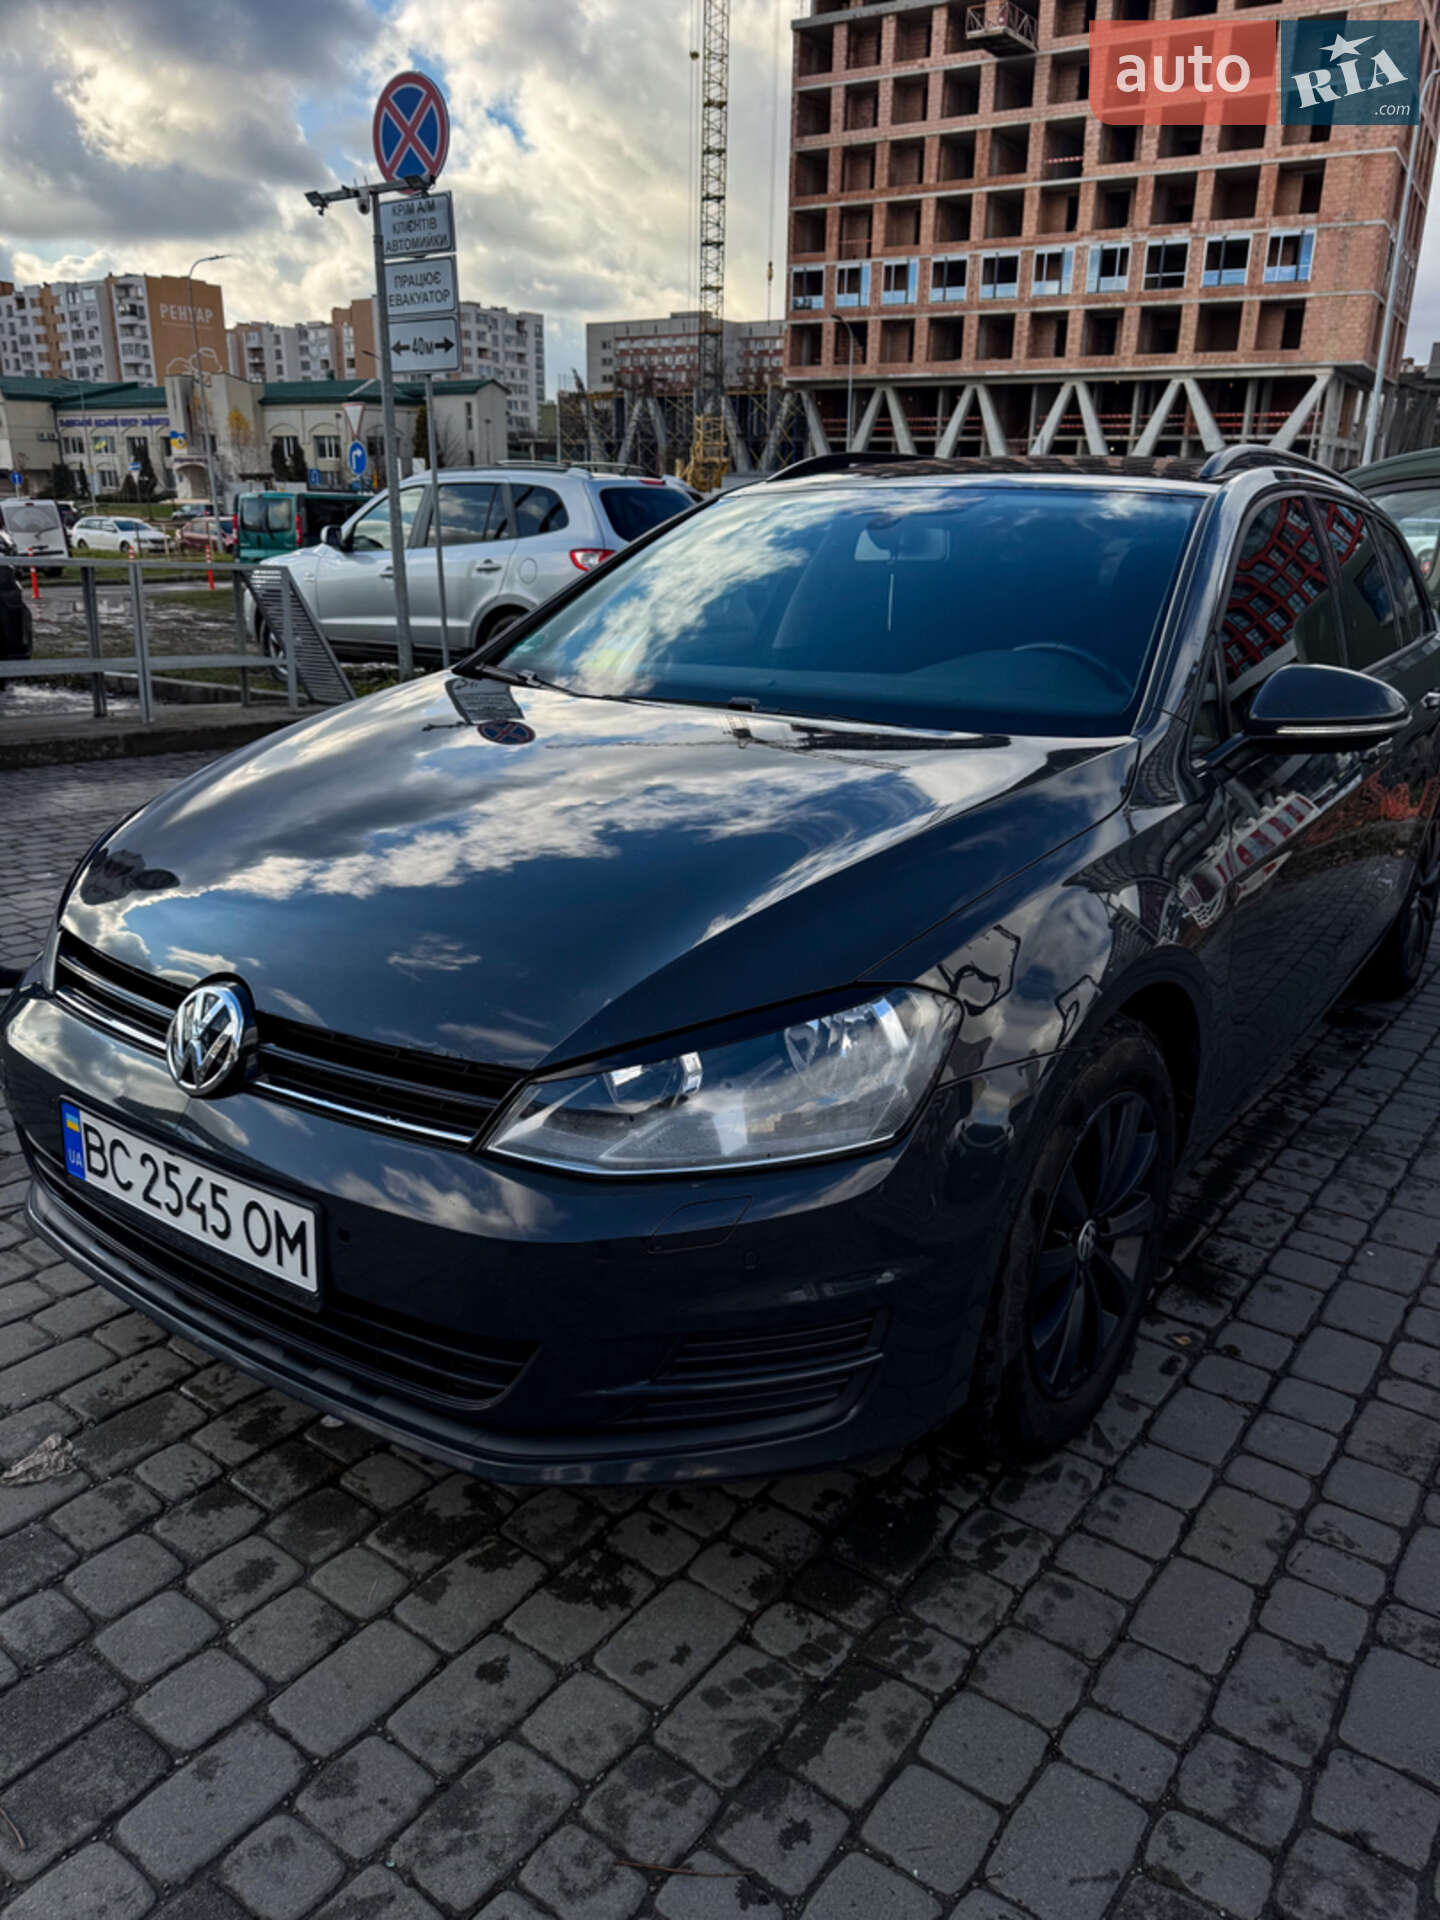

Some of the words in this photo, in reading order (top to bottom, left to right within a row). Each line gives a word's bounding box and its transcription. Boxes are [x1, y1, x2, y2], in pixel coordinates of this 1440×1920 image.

[392, 217, 437, 234] КЛІЄНТІВ
[385, 234, 448, 252] АВТОМИЙКИ
[394, 271, 442, 289] ПРАЦЮЄ
[389, 290, 450, 307] ЕВАКУАТОР
[68, 1148, 83, 1168] UA
[83, 1123, 133, 1192] BC
[140, 1152, 231, 1241] 2545
[243, 1200, 308, 1278] OM
